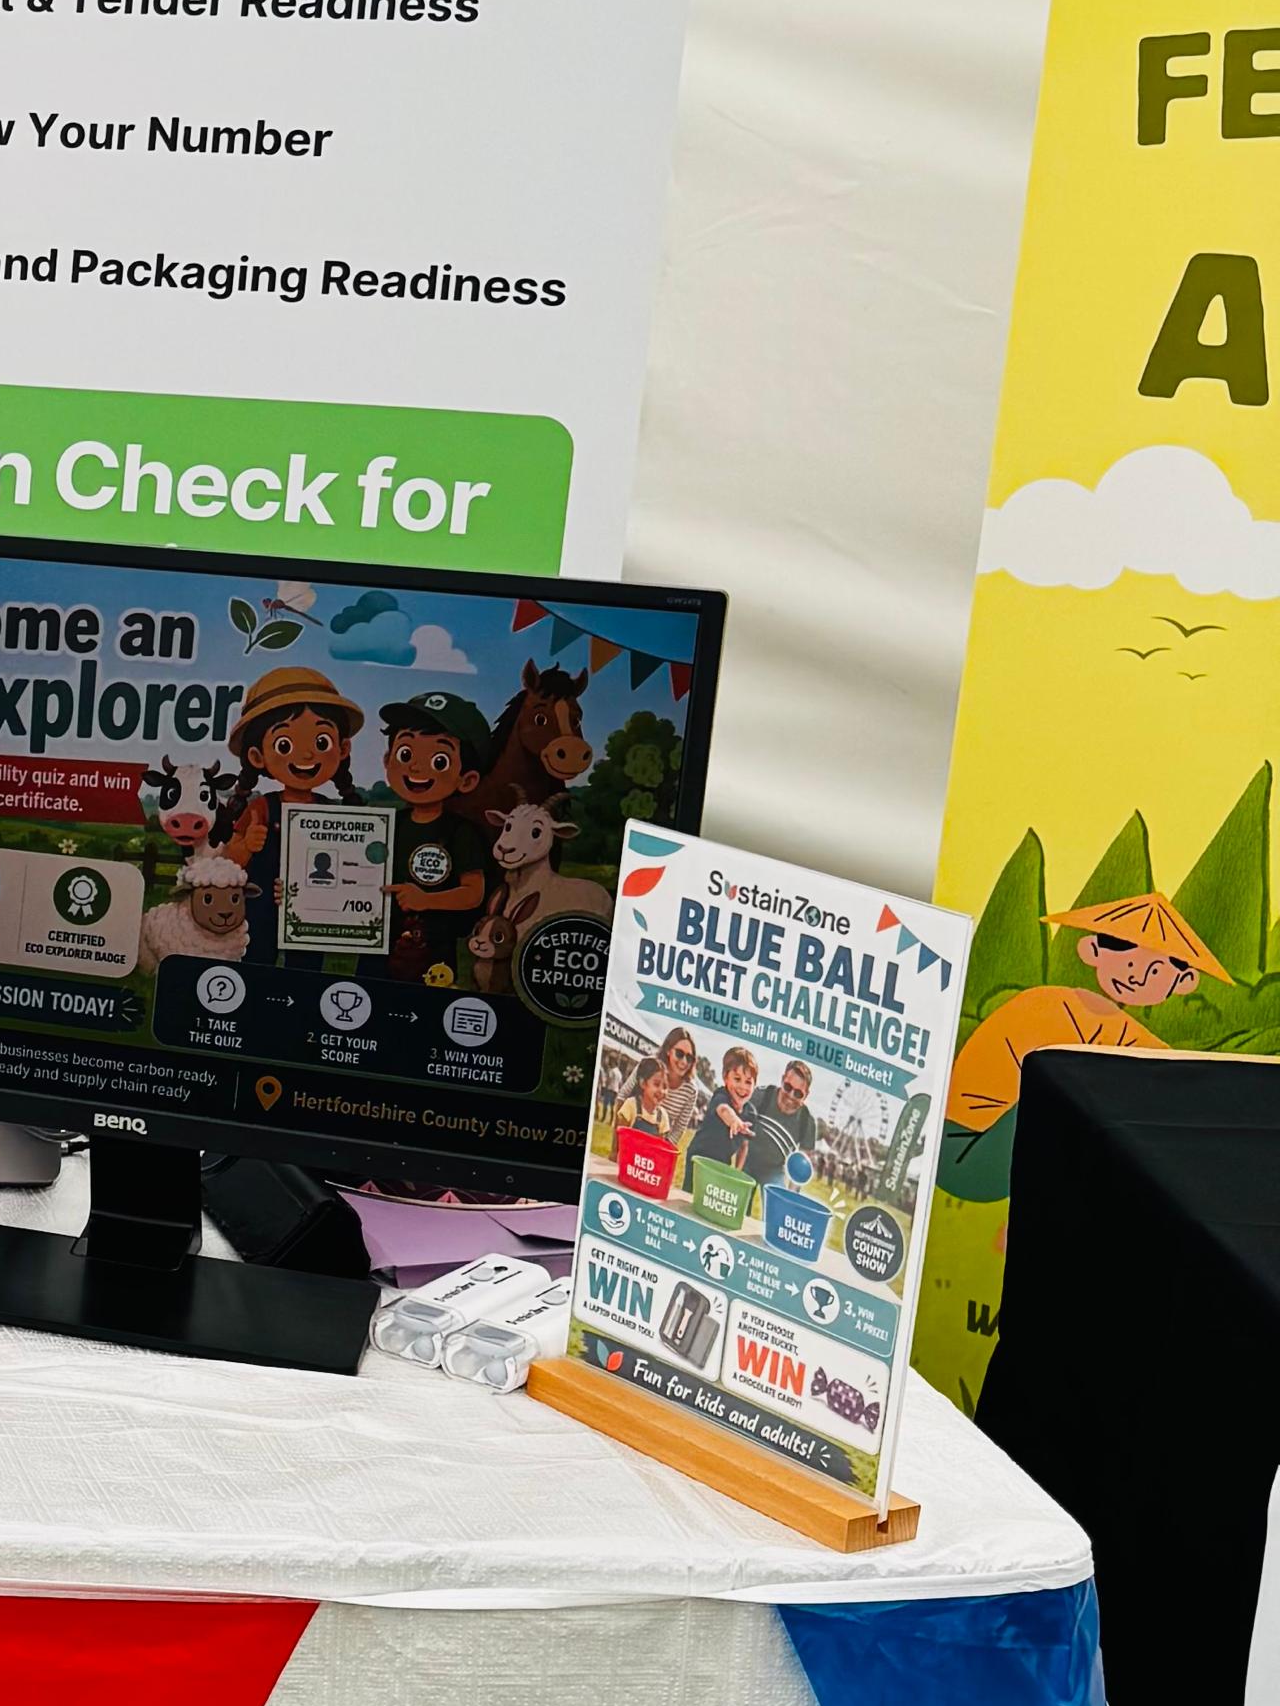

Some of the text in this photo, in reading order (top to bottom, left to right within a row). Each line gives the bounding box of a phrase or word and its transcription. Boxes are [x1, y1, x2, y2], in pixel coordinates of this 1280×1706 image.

[28, 112, 136, 151] Your
[147, 116, 334, 160] Number
[70, 250, 308, 303] Packaging
[320, 260, 568, 308] Readiness
[54, 436, 337, 527] Check
[358, 455, 492, 537] for
[119, 610, 196, 660] an
[33, 765, 65, 788] quiz
[69, 767, 99, 788] and
[104, 770, 130, 789] win
[676, 897, 905, 1013] BLUE BALL
[50, 991, 115, 1019] TODAY!
[637, 939, 931, 1068] BUCKET CHALLENGE!
[656, 994, 893, 1086] Put the BLUE ball in the BLUE bucket!
[778, 1226, 815, 1250] BUCKET
[784, 1214, 812, 1235] BLUE
[588, 1262, 653, 1322] WIN
[737, 1336, 806, 1397] WIN
[633, 1358, 816, 1459] Fun for kids and adults!
